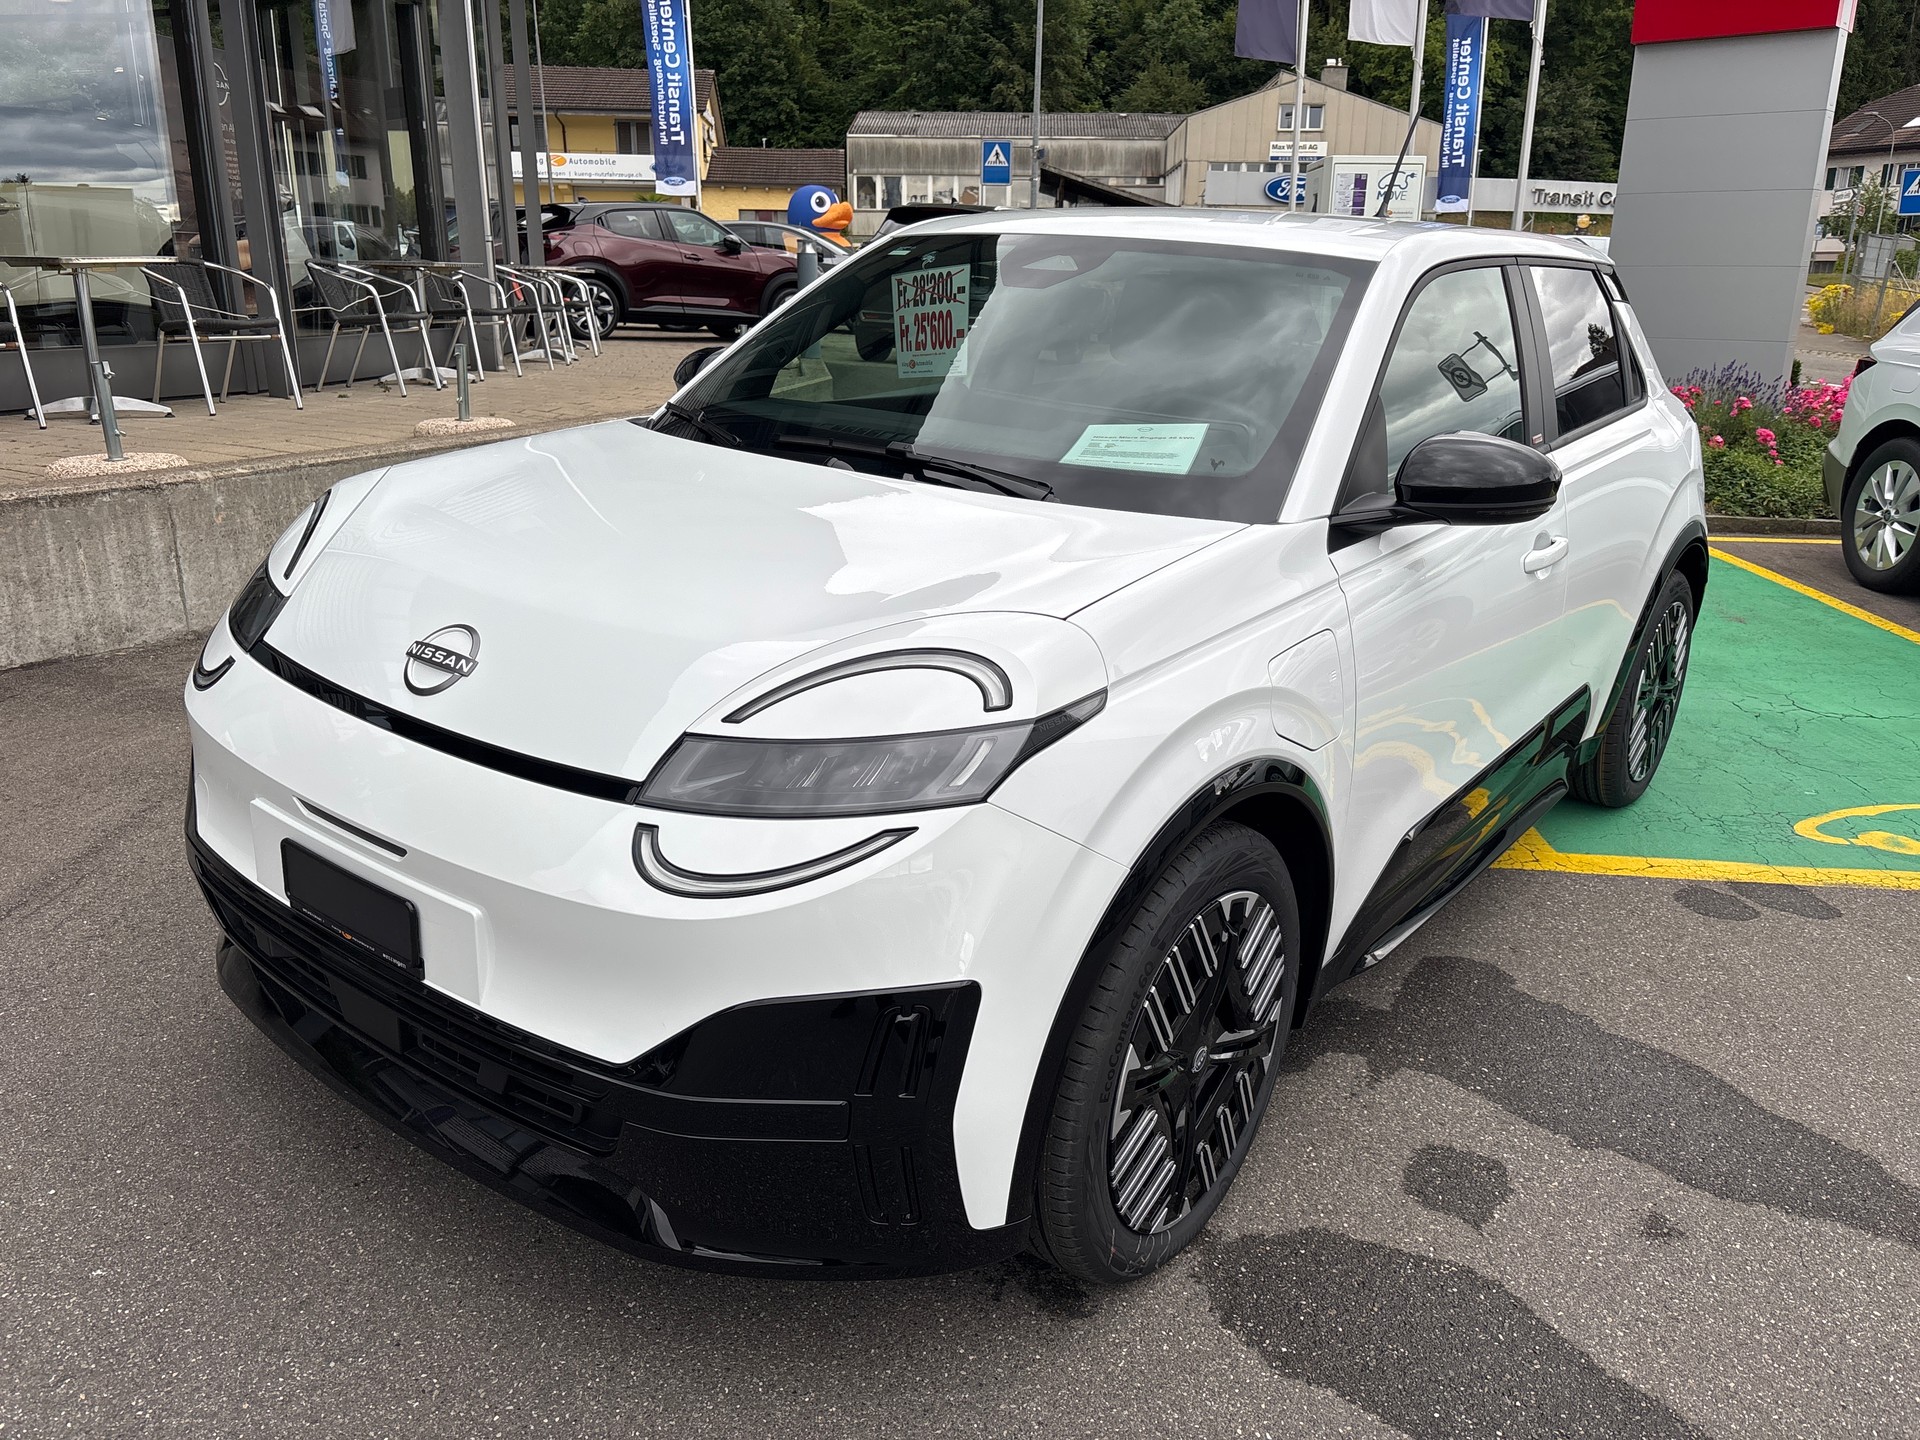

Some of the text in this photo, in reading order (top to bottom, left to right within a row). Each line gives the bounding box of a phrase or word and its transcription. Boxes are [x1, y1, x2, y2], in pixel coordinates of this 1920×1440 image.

[568, 157, 617, 166] Automobile
[1533, 188, 1595, 207] Transit
[897, 278, 910, 309] Fr.
[899, 309, 965, 352] Fr. 25'600.-
[408, 643, 473, 673] NISSAN
[1100, 990, 1141, 1104] EcoContact
